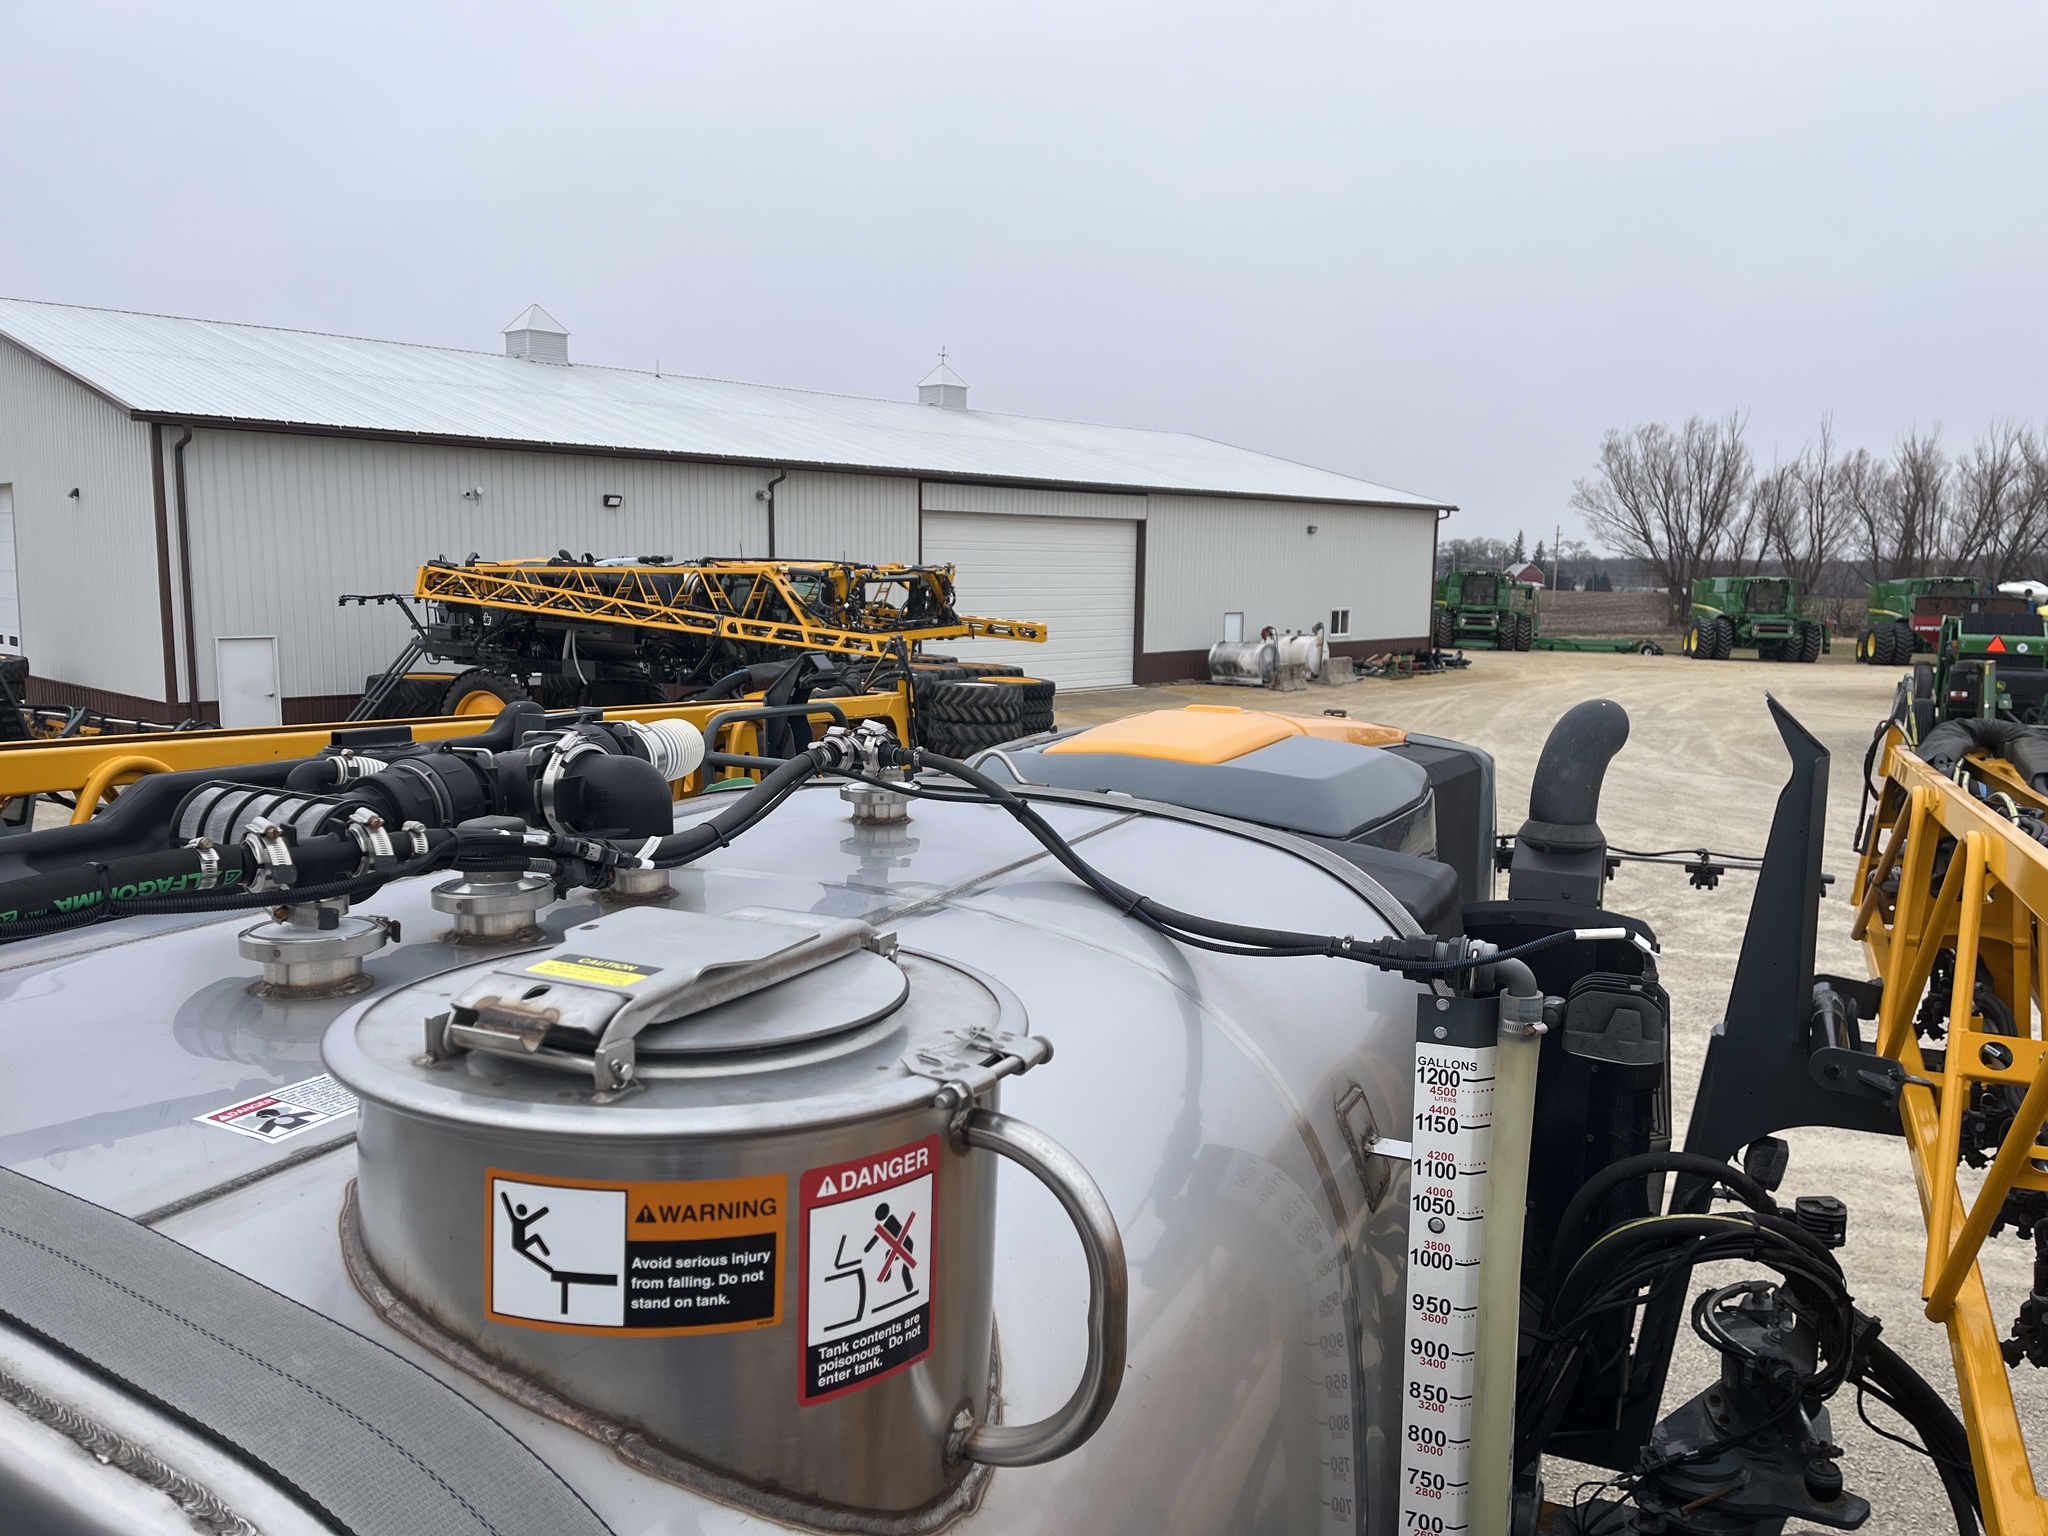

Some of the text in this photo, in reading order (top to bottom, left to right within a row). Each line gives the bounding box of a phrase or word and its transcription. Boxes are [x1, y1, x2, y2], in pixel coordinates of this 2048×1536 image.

[23, 908, 48, 920] ITALY
[578, 958, 638, 972] CAUTION
[1418, 1056, 1478, 1072] GALLONS
[1416, 1067, 1460, 1088] 1200
[1430, 1086, 1457, 1098] 4500
[1434, 1096, 1457, 1104] LITERS
[1429, 1104, 1456, 1116] 4400
[1415, 1114, 1458, 1134] 1150
[1427, 1150, 1454, 1162] 4200
[840, 1147, 929, 1193] DANGER
[1414, 1159, 1457, 1180] 1100
[1426, 1186, 1453, 1198] 4000
[659, 1197, 778, 1224] WARNING
[1412, 1194, 1455, 1216] 1050
[1424, 1240, 1450, 1252] 3800
[631, 1250, 771, 1270] Avoid serious injury
[1410, 1249, 1453, 1270] 1000
[630, 1270, 764, 1291] from falling. Do not
[630, 1294, 730, 1310] stand on tank.
[1412, 1294, 1451, 1316] 950
[1421, 1312, 1448, 1325] 3600
[818, 1314, 920, 1360] Tank contents are
[818, 1324, 922, 1377] poisonous. Do not
[1410, 1338, 1450, 1360] 900
[818, 1358, 884, 1388] enter tank.
[1420, 1356, 1446, 1370] 3400
[1409, 1381, 1448, 1404] 850
[1418, 1400, 1445, 1413] 3200
[1408, 1424, 1446, 1448] 800
[1416, 1444, 1444, 1456] 3000
[1407, 1468, 1445, 1491] 750
[1415, 1486, 1442, 1500] 2800
[1406, 1510, 1444, 1534] 700
